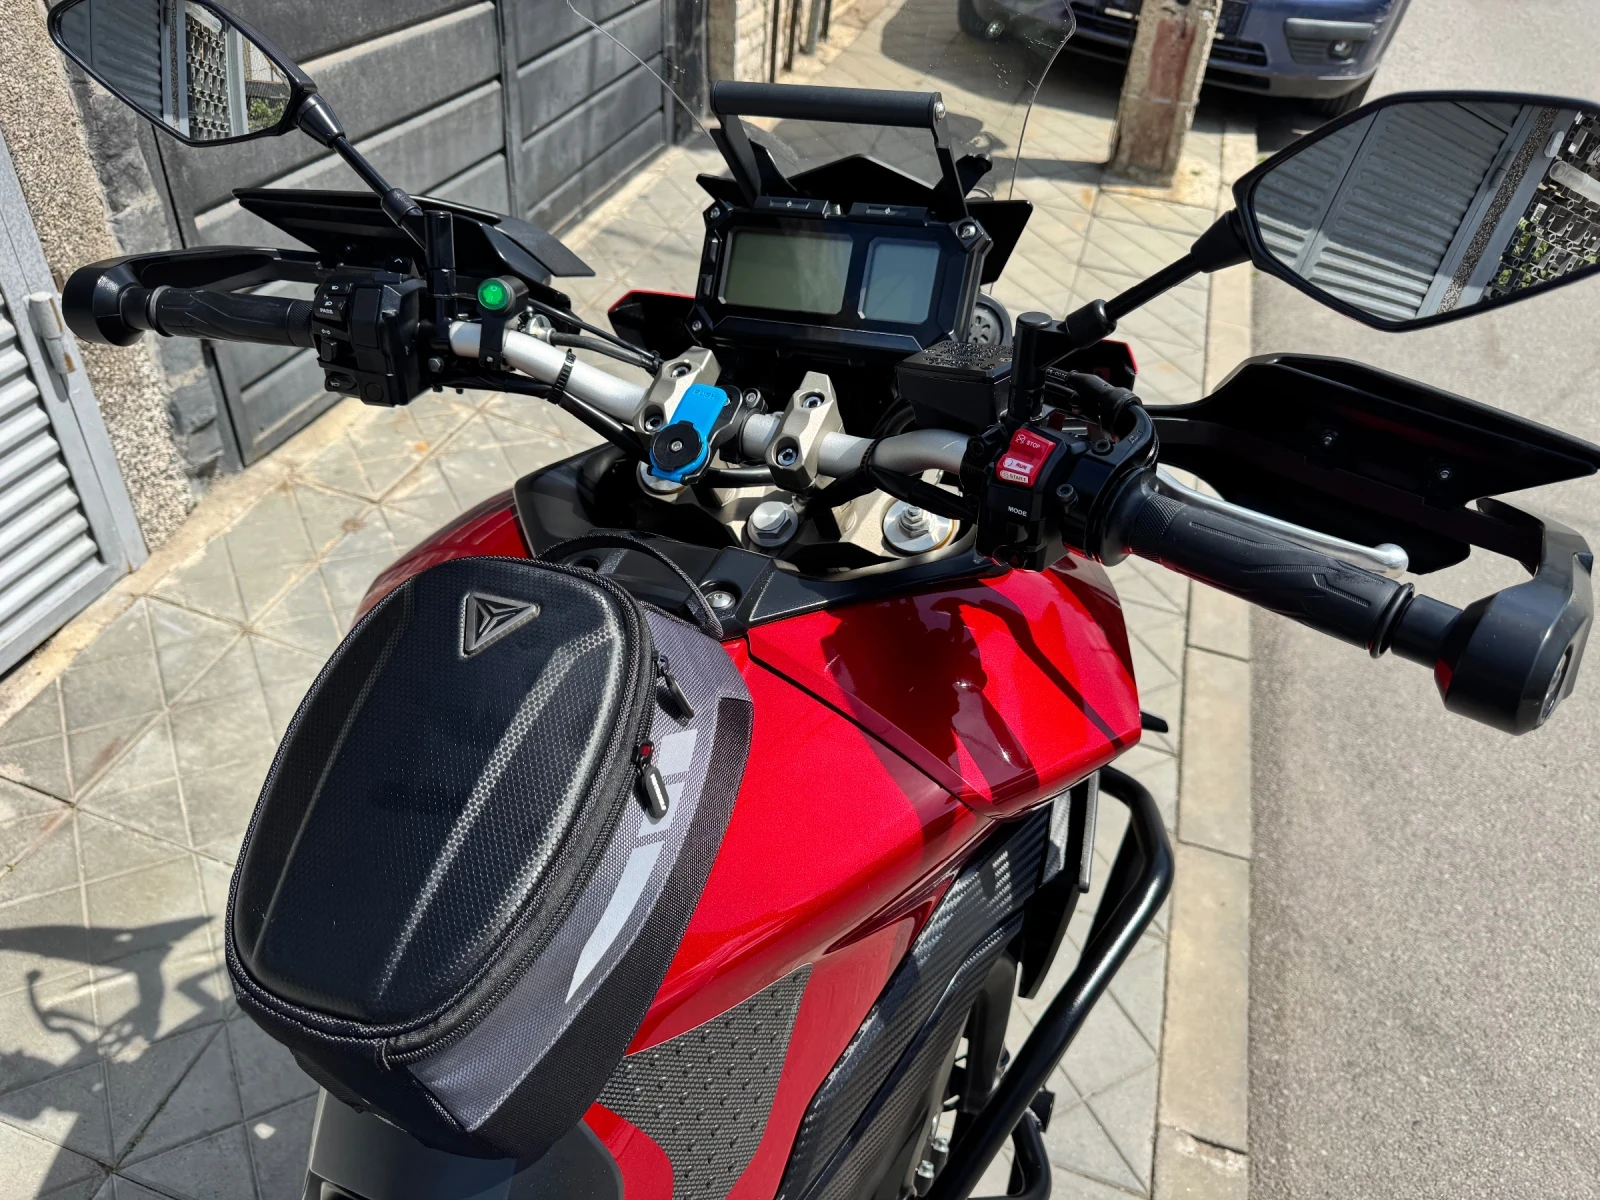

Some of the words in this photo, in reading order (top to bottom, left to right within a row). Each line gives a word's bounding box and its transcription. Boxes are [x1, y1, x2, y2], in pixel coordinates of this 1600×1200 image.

[1026, 440, 1040, 448] STOP
[1010, 473, 1026, 481] START
[1008, 505, 1027, 517] MODE
